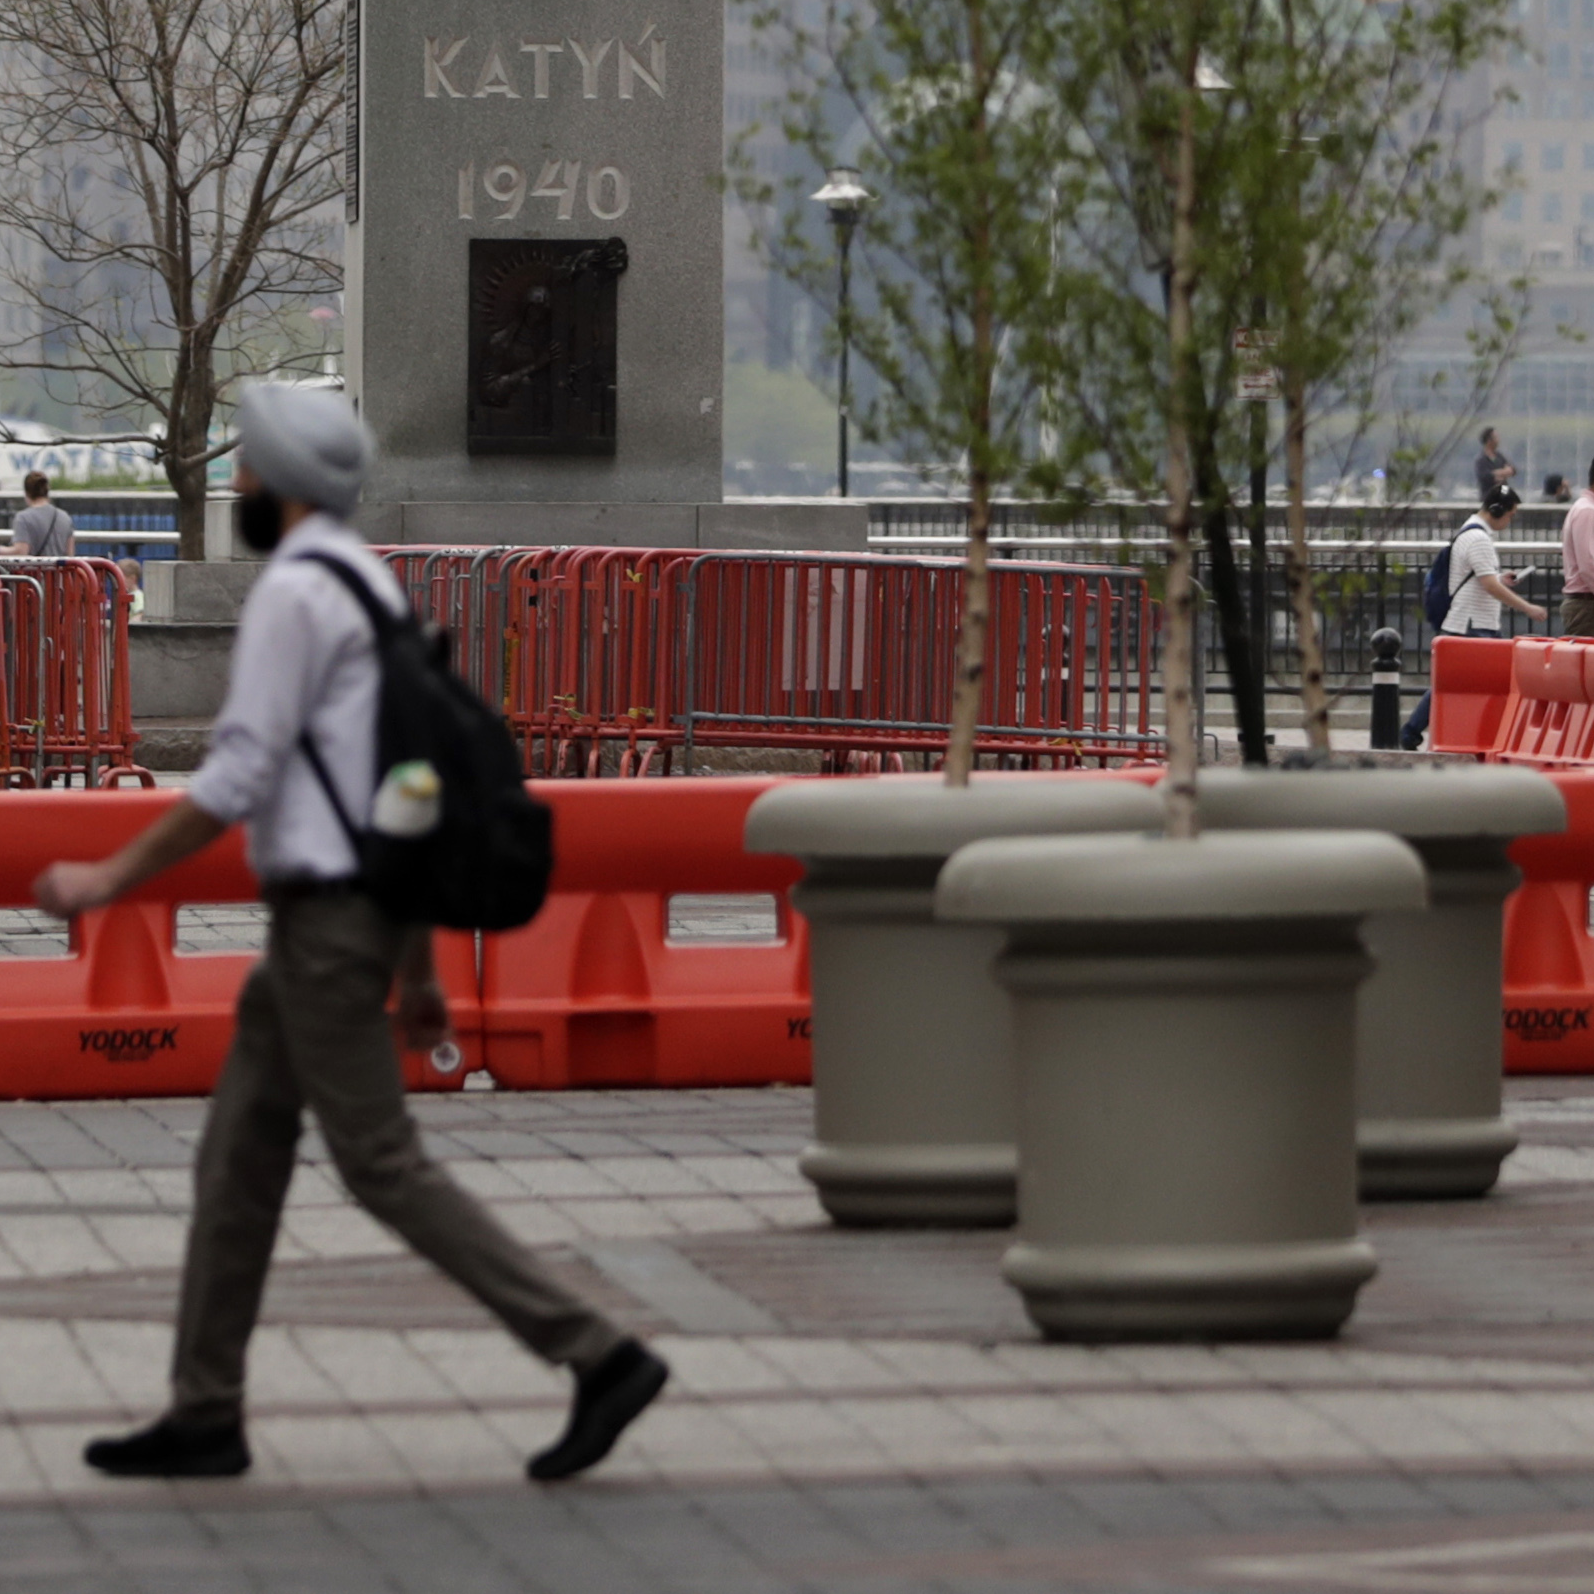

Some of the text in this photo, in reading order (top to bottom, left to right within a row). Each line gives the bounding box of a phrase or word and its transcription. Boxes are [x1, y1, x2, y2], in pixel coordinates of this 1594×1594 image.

[423, 16, 668, 100] KATYŃ
[458, 158, 631, 221] 1940
[78, 1024, 181, 1052] YODOCK
